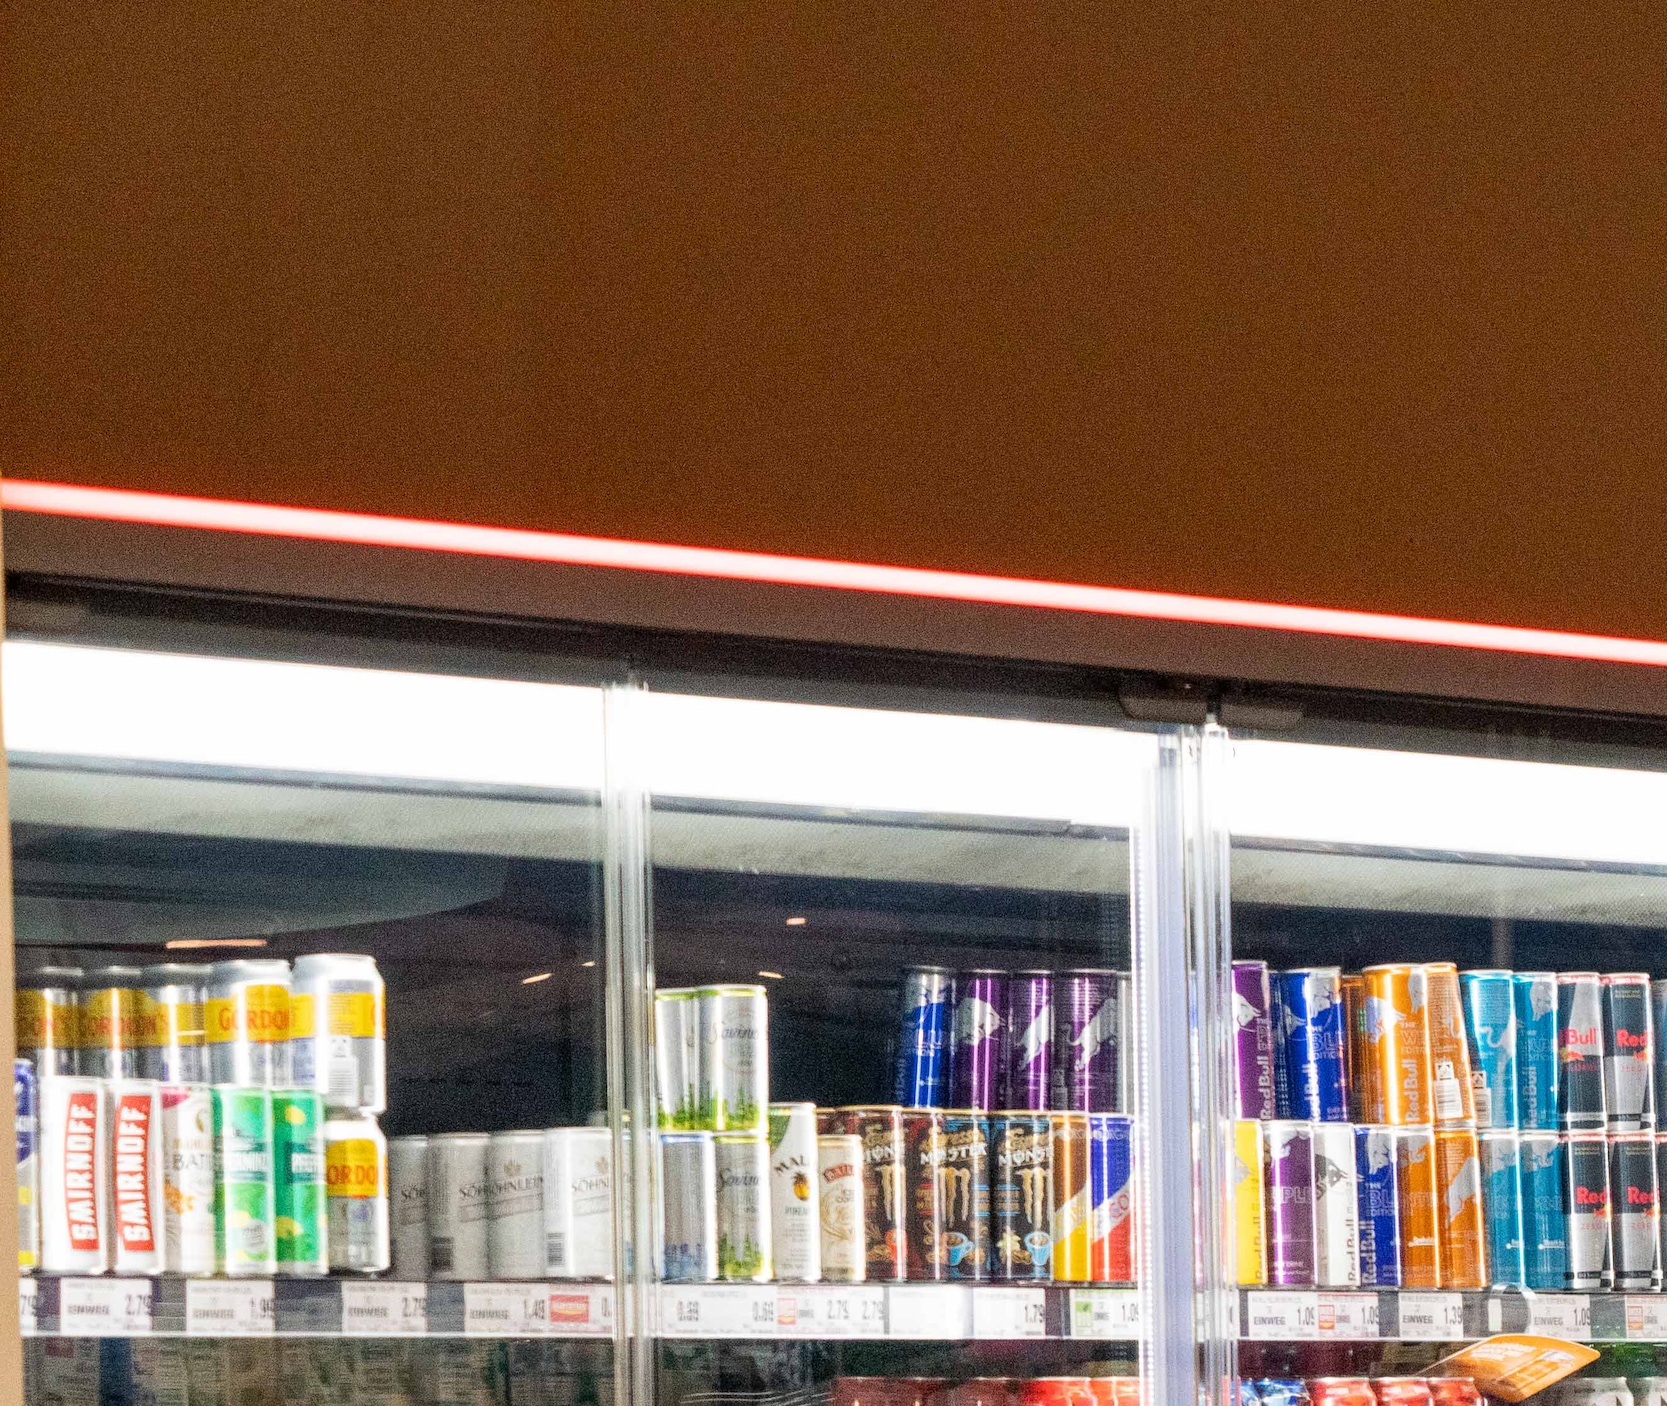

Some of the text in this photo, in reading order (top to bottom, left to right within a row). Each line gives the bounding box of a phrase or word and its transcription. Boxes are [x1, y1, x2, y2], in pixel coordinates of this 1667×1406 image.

[71, 1104, 95, 1241] SMIRNOFF
[121, 1105, 151, 1242] SMIRNOFF
[1253, 1315, 1286, 1325] EINWEG
[1297, 1307, 1315, 1325] 1.09
[1361, 1306, 1379, 1324] 1.09
[1402, 1315, 1434, 1325] EINWEG
[1444, 1306, 1462, 1324] 1.39
[1534, 1315, 1564, 1326] EINWEG
[1573, 1306, 1591, 1325] 1.09
